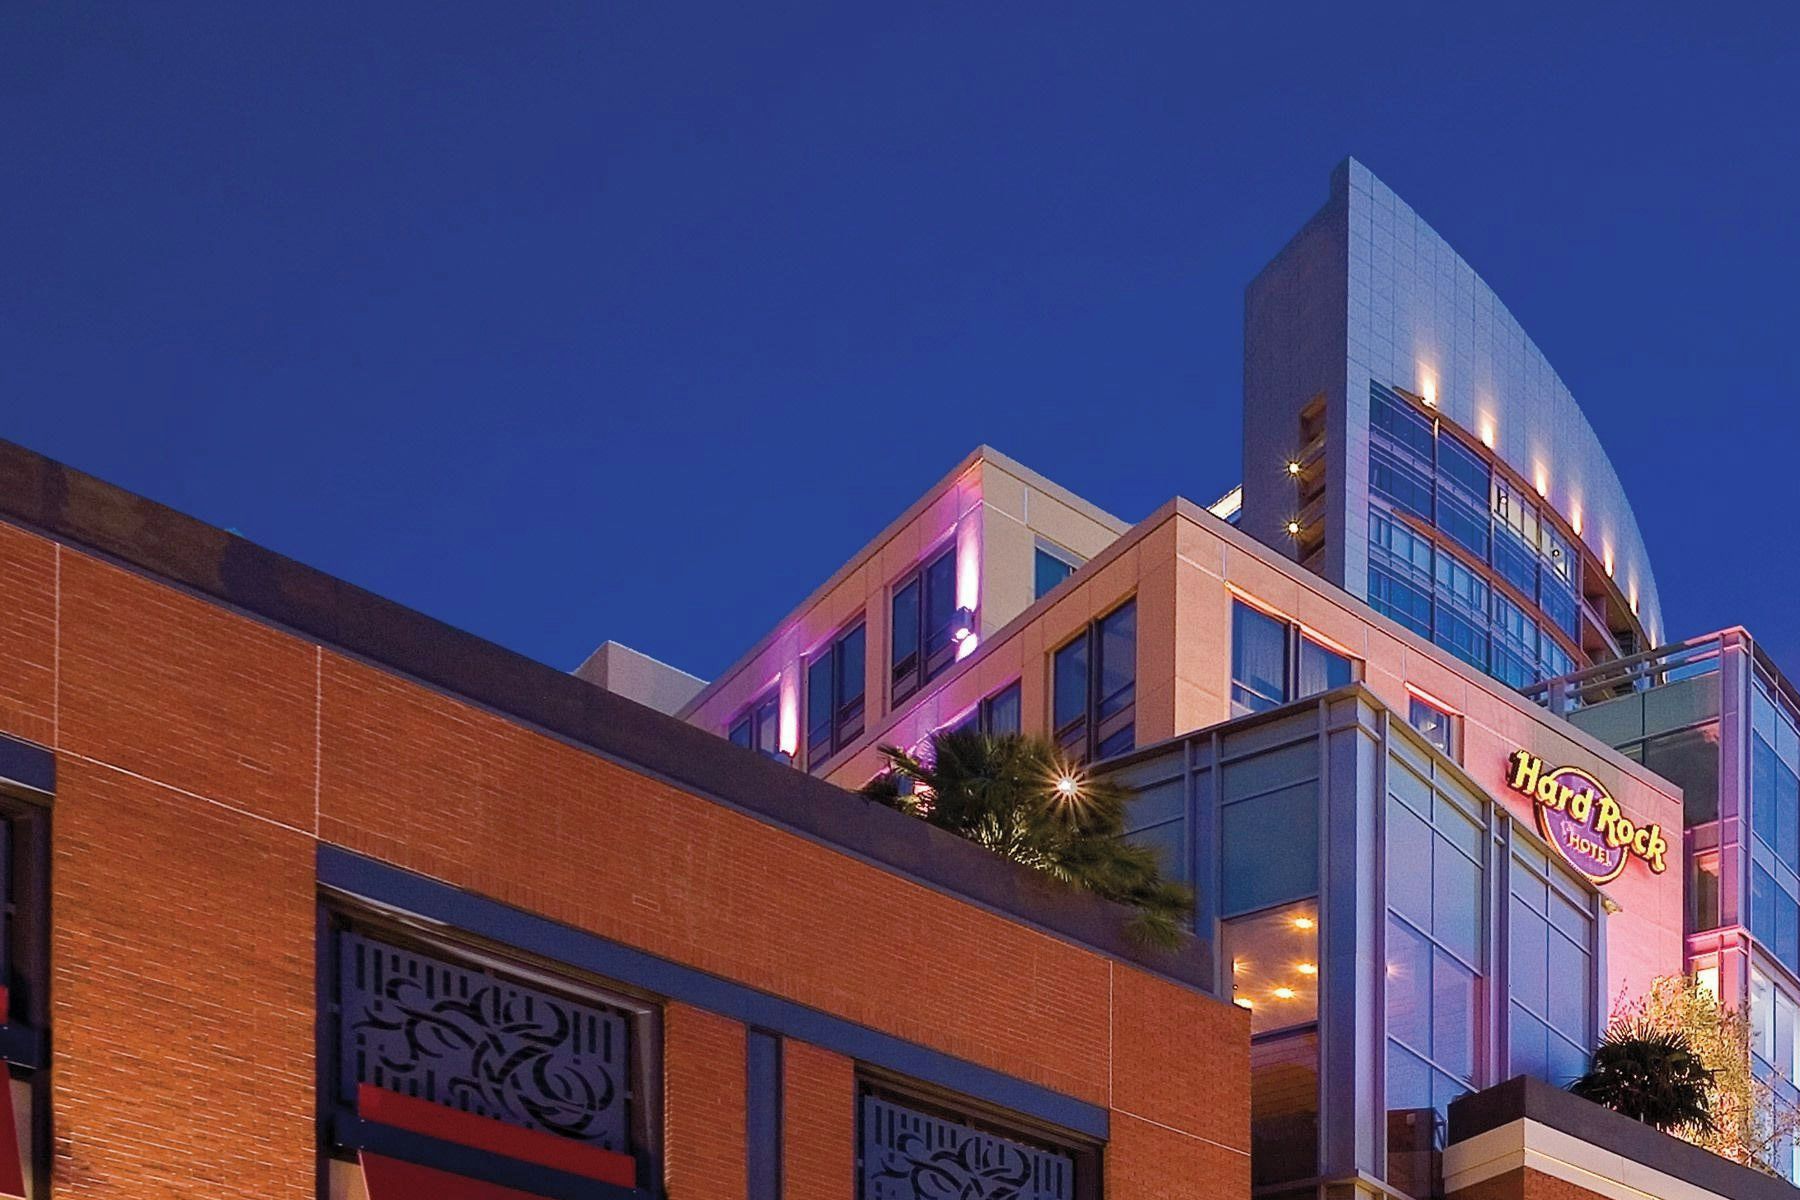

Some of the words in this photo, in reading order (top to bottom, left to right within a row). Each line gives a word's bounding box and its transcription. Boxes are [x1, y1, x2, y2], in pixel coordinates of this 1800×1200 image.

[1510, 749, 1594, 824] Hard
[1596, 797, 1667, 874] Rock
[1569, 834, 1613, 867] HOTEL
